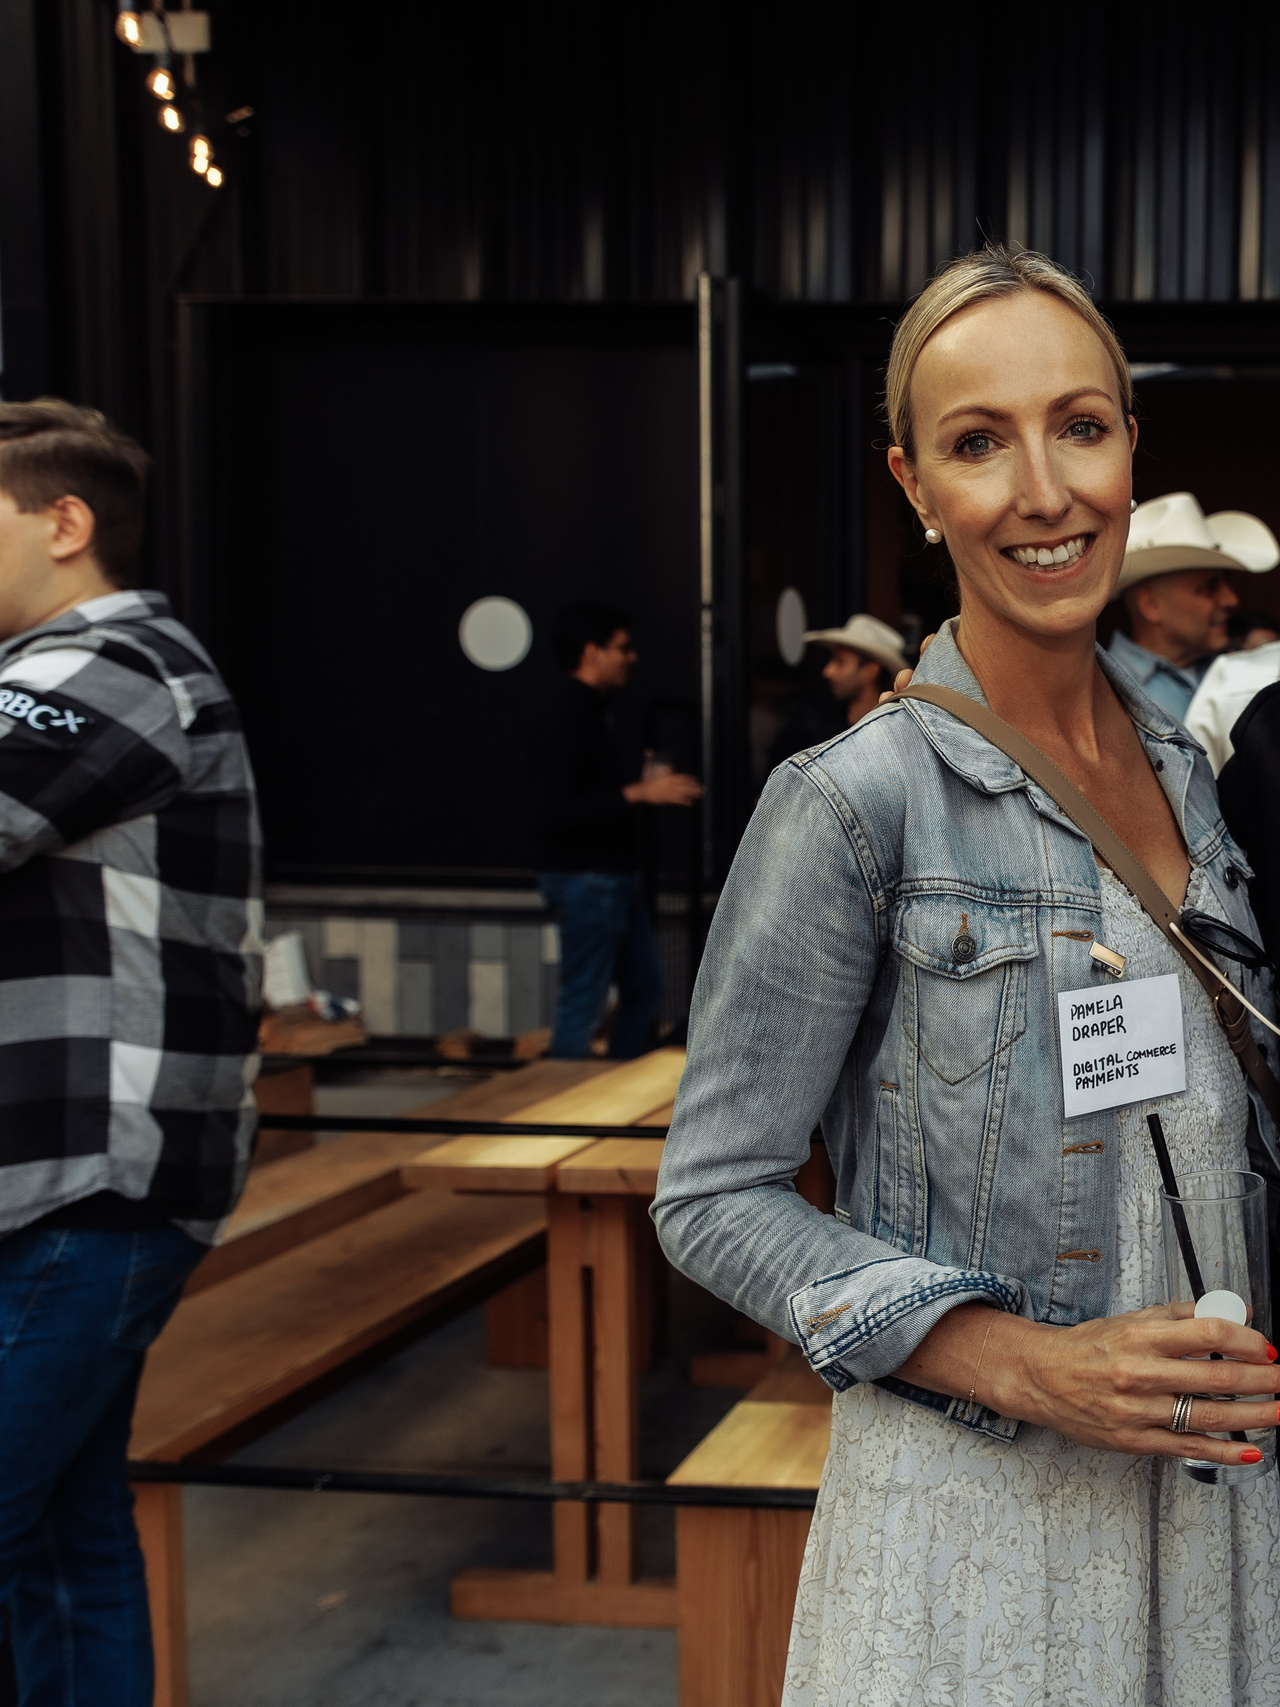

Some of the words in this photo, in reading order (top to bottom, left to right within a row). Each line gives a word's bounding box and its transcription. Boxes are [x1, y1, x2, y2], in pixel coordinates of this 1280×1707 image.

[1070, 994, 1123, 1021] PAMELA
[1072, 1015, 1127, 1042] DRAPER
[1073, 1053, 1123, 1076] DIGITAL
[1126, 1043, 1177, 1061] COMMERCE
[1075, 1063, 1140, 1090] PAYMENTS
